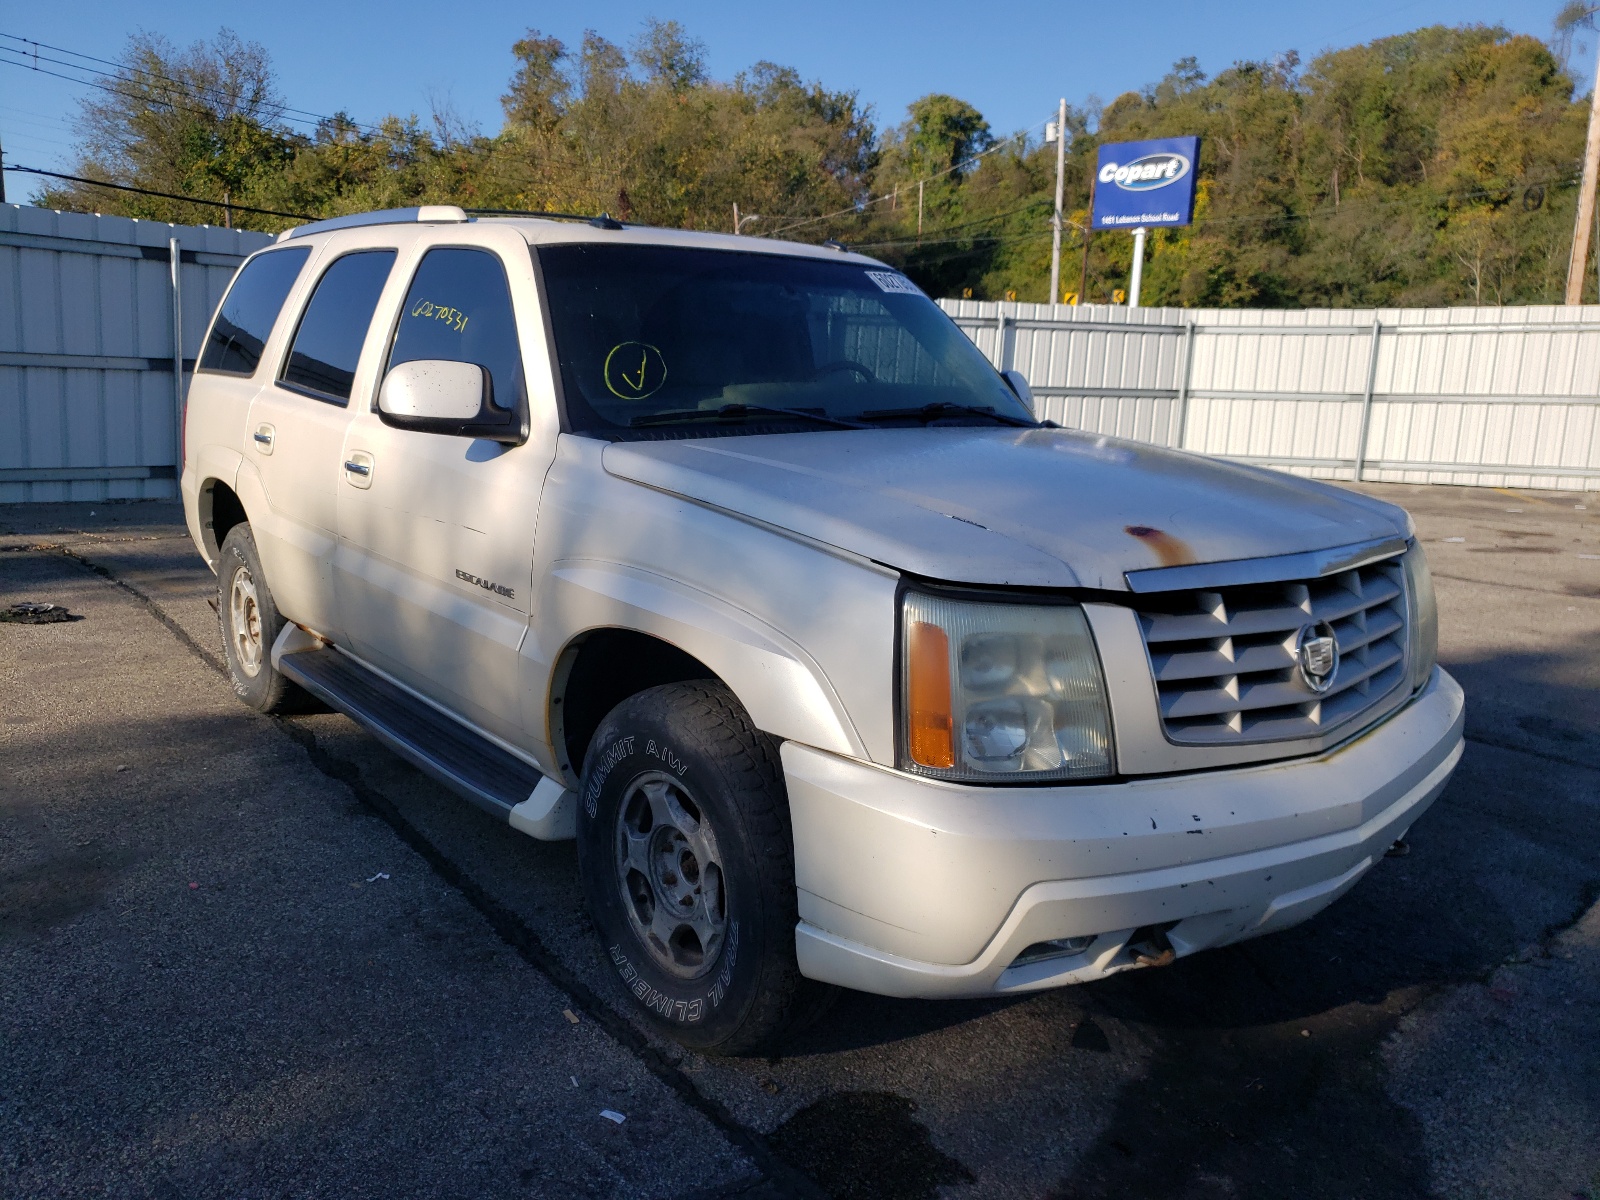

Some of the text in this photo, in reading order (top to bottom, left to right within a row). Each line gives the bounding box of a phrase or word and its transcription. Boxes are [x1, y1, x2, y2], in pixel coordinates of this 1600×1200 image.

[1099, 158, 1179, 185] Copart
[1141, 213, 1161, 223] School
[1163, 212, 1179, 222] Road
[411, 297, 469, 333] 60270531
[455, 568, 515, 600] ESCALADE
[585, 735, 635, 818] SUMMIT
[609, 920, 739, 1022] TRAIL CLIMBER
